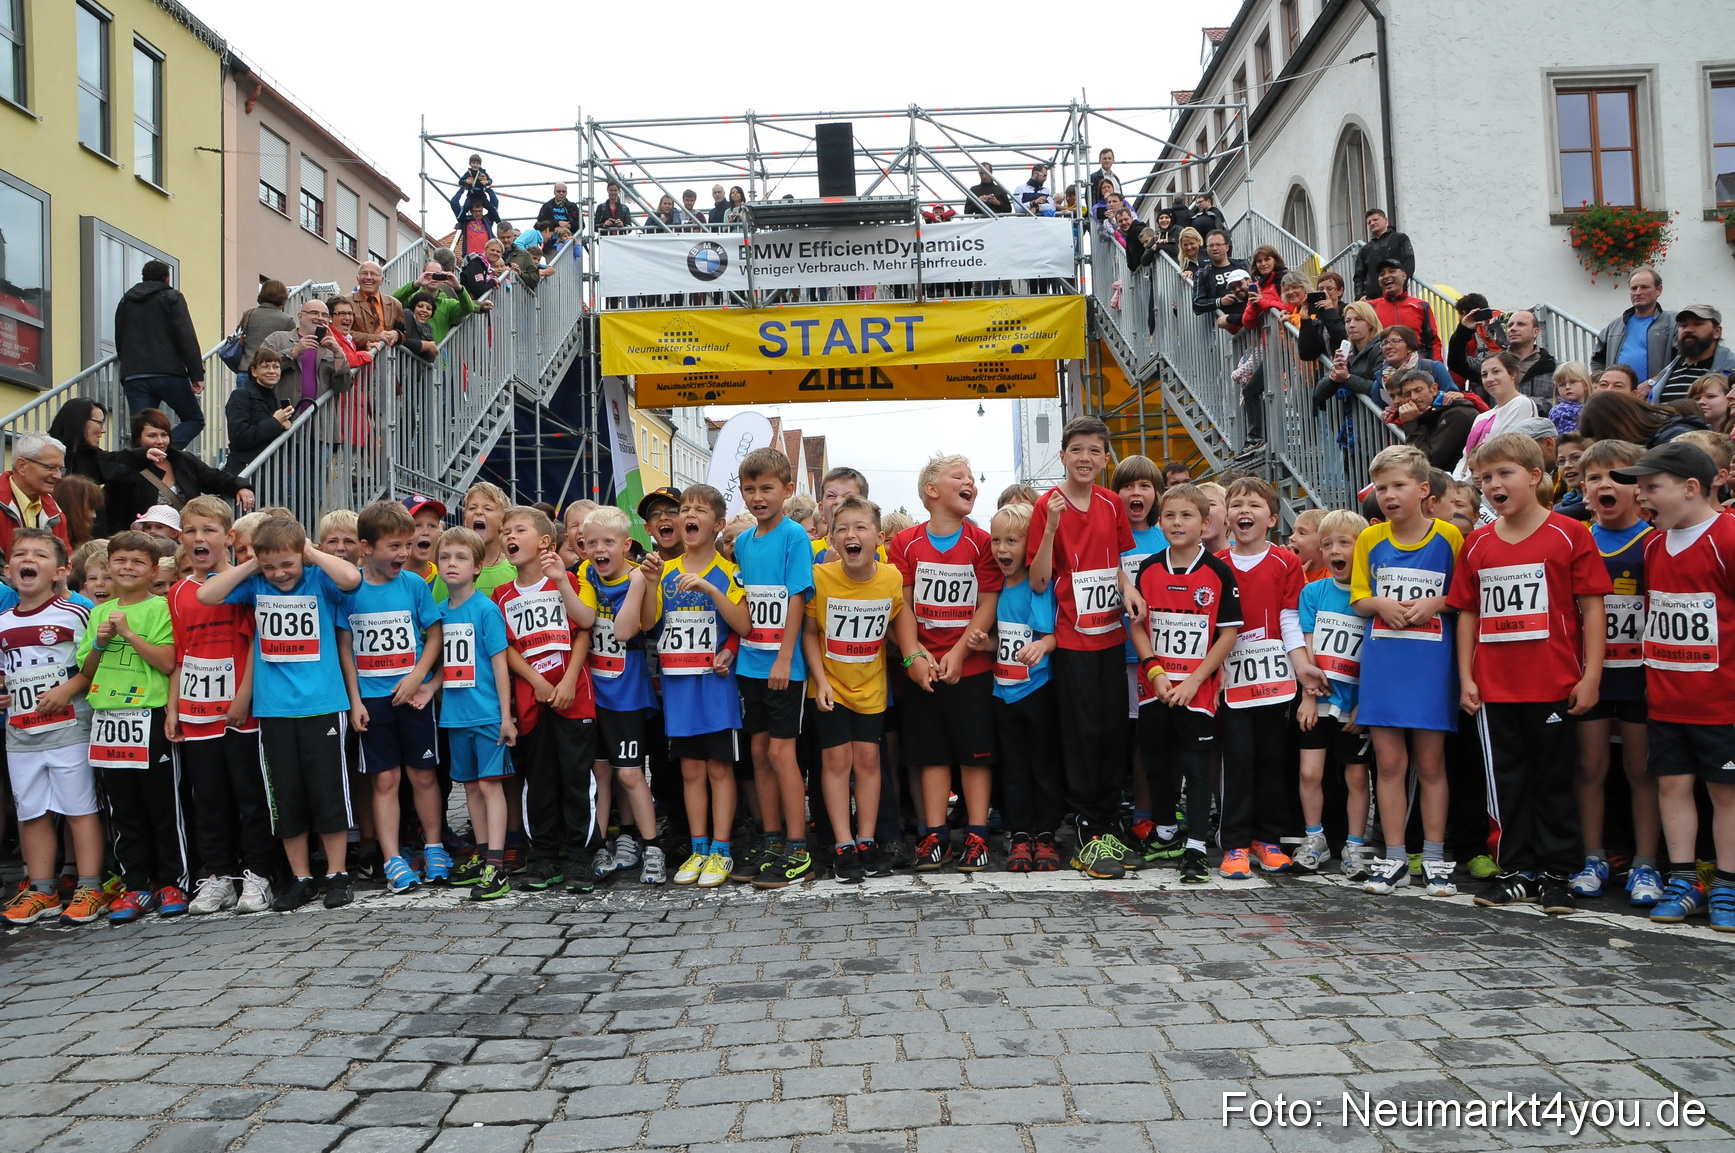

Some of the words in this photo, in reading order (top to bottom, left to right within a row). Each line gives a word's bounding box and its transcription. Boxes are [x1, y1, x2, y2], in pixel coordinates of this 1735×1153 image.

[690, 242, 725, 256] BMW
[738, 242, 793, 260] BMW
[799, 236, 985, 258] EfficientDynamics
[739, 264, 795, 278] Weniger
[797, 260, 869, 274] Verbrauch.
[873, 257, 907, 271] Mehr
[910, 255, 987, 270] Fahrfreude.
[758, 315, 924, 358] START
[955, 333, 1011, 343] Neumarkter
[1014, 330, 1059, 341] Stadtlauf
[628, 344, 683, 354] Neumarkter
[686, 342, 731, 352] Stadtlauf
[724, 472, 740, 502] BKK
[917, 567, 938, 576] PARTL
[1494, 572, 1532, 582] Neumarkt
[1074, 577, 1097, 585] PARTL
[1397, 575, 1433, 584] Neumarkt
[921, 578, 973, 603] 7087
[1483, 582, 1540, 613] 7047
[257, 601, 272, 609] PARTL
[507, 603, 523, 614] PARTL
[523, 597, 556, 608] Neumarkt
[828, 603, 852, 612] PARTL
[853, 605, 884, 613] Neumarkt
[1661, 600, 1700, 608] Neumarkt
[750, 601, 782, 625] 200
[922, 606, 968, 618] Maximilian
[259, 611, 314, 636] 7036
[368, 617, 401, 626] Neumarkt
[513, 605, 564, 635] 7034
[833, 614, 885, 638] 7173
[1164, 619, 1197, 627] Neumarkt
[1317, 617, 1339, 626] PARTL
[1341, 621, 1366, 631] Neuma
[1495, 620, 1525, 631] Lukas
[1605, 612, 1637, 640] 84
[1650, 610, 1709, 641] 7008
[357, 626, 410, 653] 7233
[662, 626, 711, 650] 7514
[1152, 628, 1202, 655] 7137
[1320, 628, 1364, 657] 707
[268, 643, 297, 653] Julian
[444, 639, 469, 662] 10
[846, 644, 872, 654] Robin
[999, 638, 1025, 662] 58
[1245, 646, 1279, 655] Neumarkt
[1651, 645, 1700, 660] Sebastian
[194, 664, 222, 672] Neumarkt
[370, 658, 394, 668] Louis
[1162, 659, 1182, 671] Leon
[1230, 654, 1288, 684] 7015
[19, 672, 55, 684] Neumarkt
[184, 672, 226, 698] 7211
[1251, 686, 1270, 697] Luis
[190, 704, 206, 714] Erik
[97, 719, 143, 743] 7005
[107, 749, 126, 758] Max
[618, 741, 638, 758] 10
